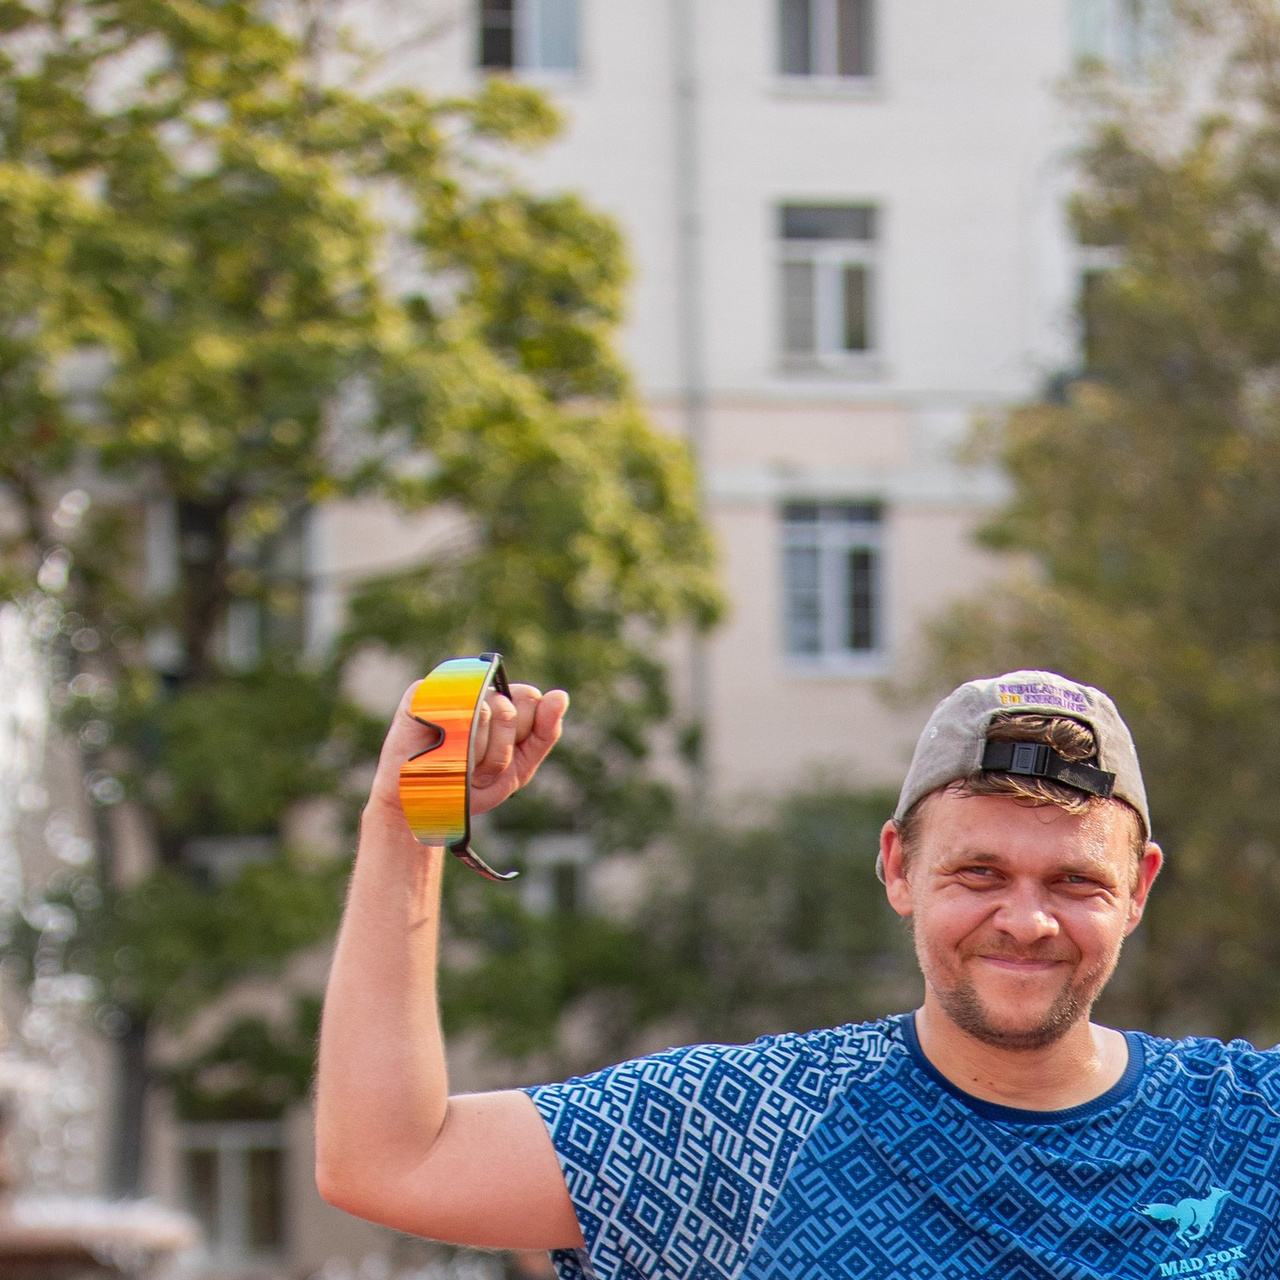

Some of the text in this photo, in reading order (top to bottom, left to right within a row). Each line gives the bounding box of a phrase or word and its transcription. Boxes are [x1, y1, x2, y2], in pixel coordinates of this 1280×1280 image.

[999, 693, 1020, 704] TO
[1158, 1245, 1247, 1278] MAD FOX
